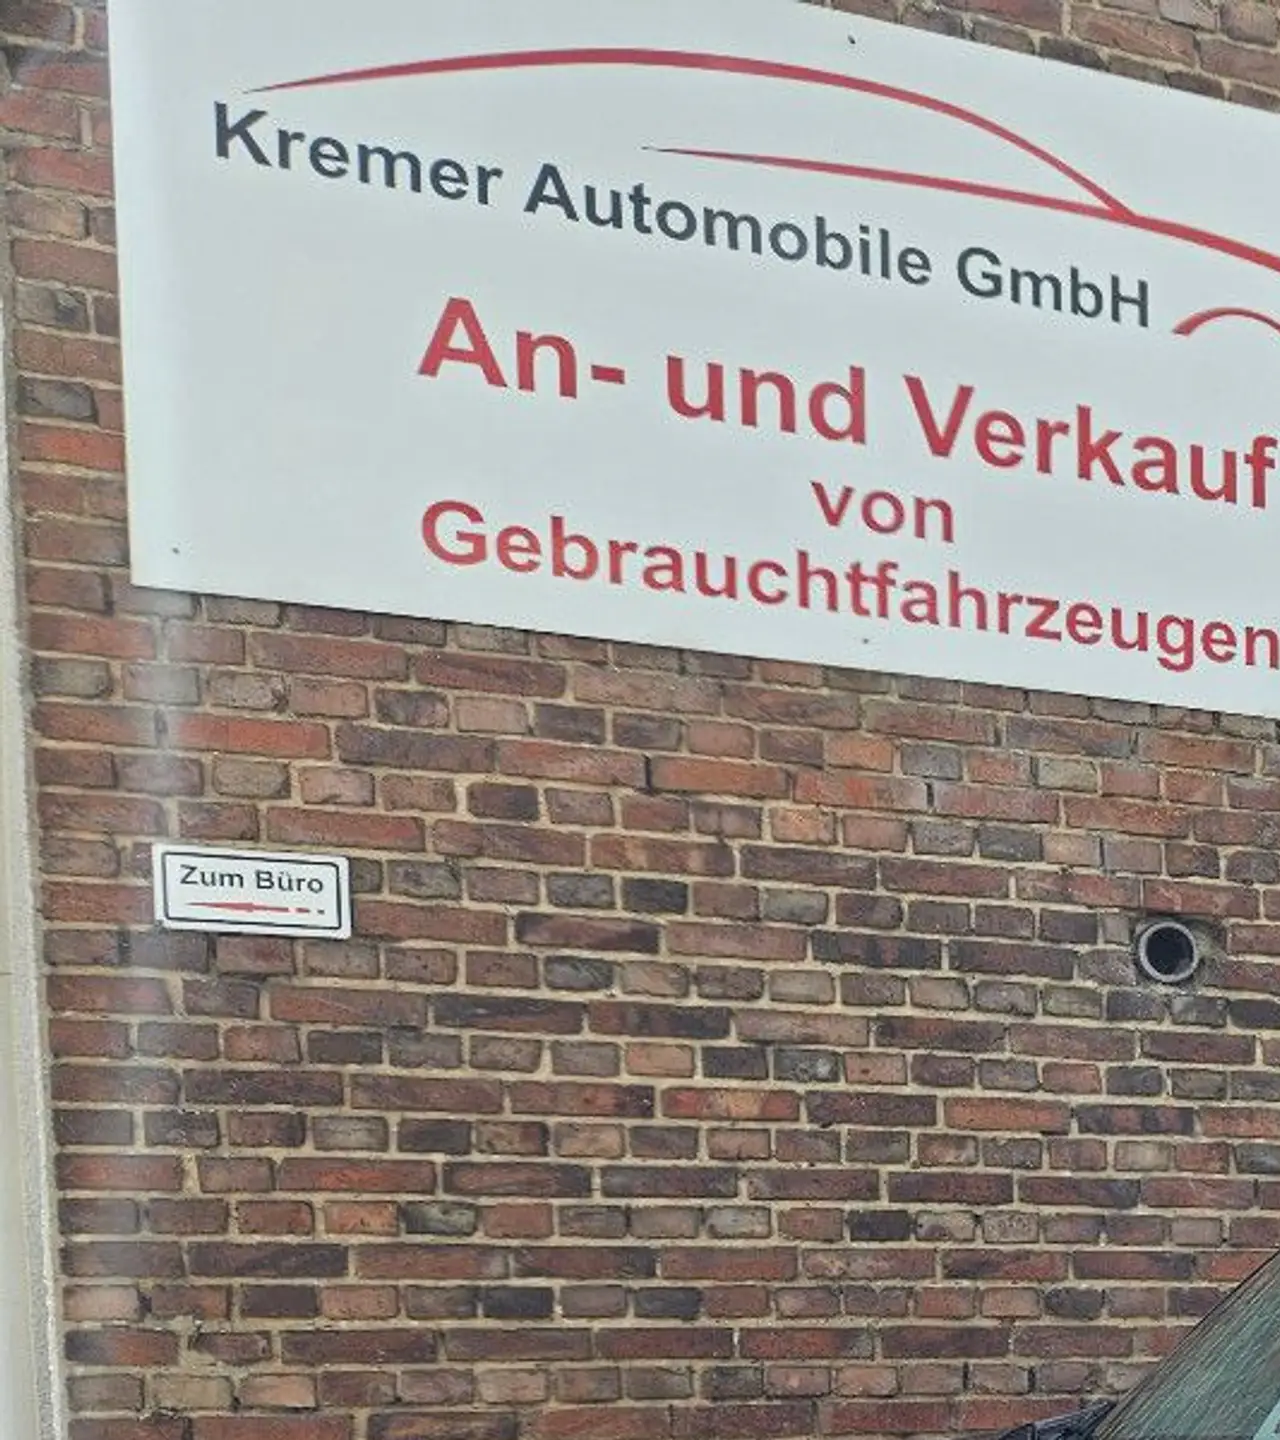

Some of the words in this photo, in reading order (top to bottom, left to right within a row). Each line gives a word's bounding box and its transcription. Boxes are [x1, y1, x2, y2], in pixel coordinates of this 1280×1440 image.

[213, 101, 504, 206] Kremer
[523, 163, 932, 285] Automobile
[956, 247, 1150, 329] GmbH
[419, 298, 625, 399] An-
[666, 356, 867, 444] und
[903, 375, 1277, 507] Verkauf
[421, 499, 1280, 673] Gebrauchtfahrzeugen
[811, 481, 954, 542] von
[180, 863, 245, 889] Zum
[255, 868, 324, 894] Büro
